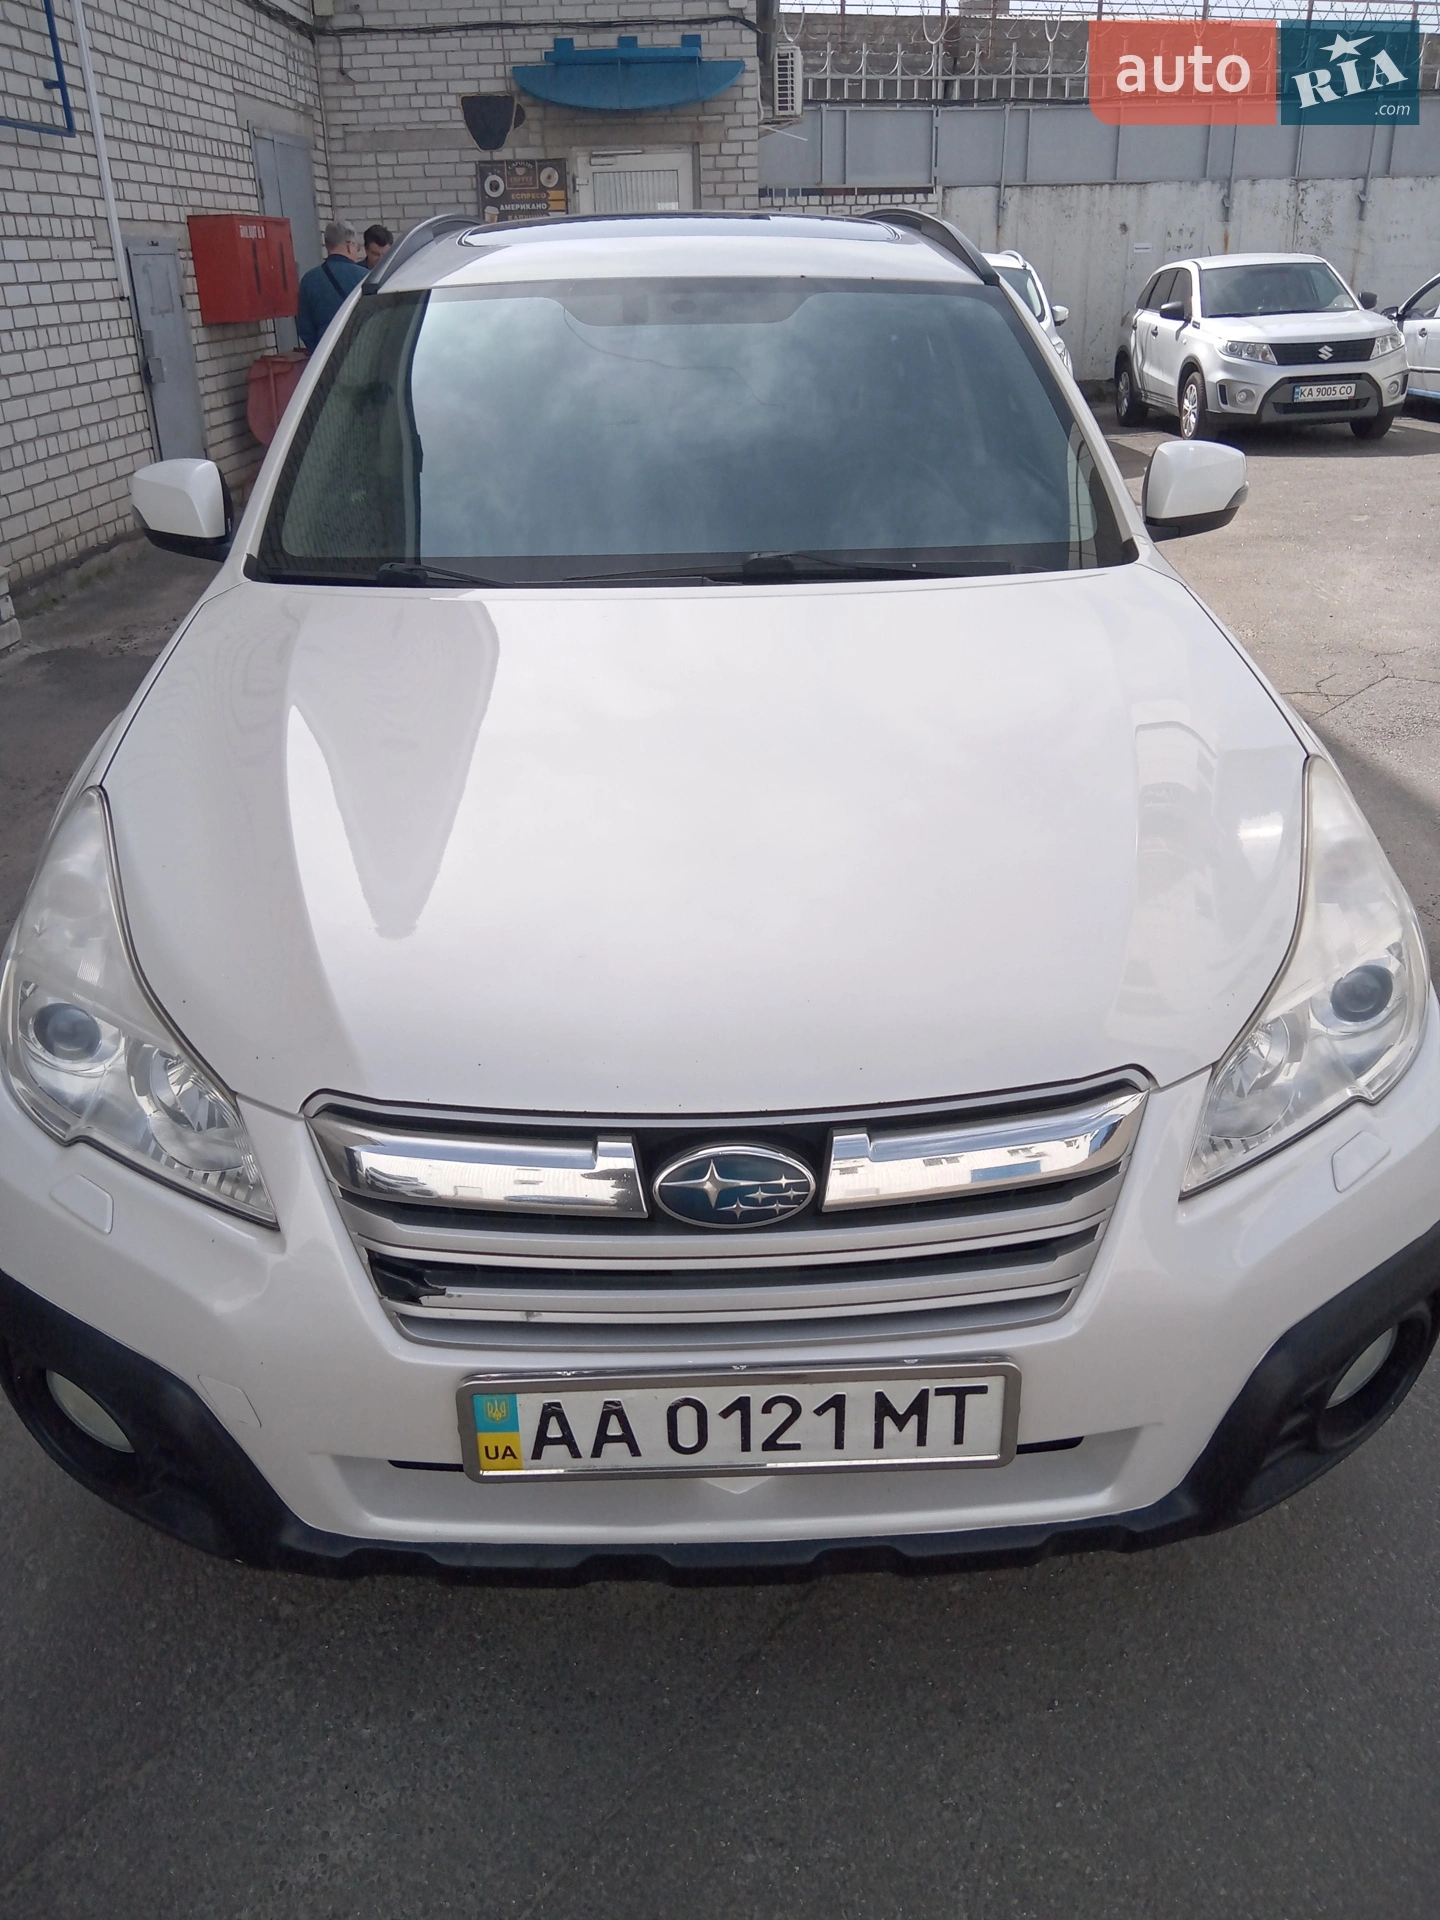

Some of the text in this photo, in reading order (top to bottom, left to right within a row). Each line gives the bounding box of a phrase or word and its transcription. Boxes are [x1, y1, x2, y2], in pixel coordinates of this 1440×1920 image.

[500, 203, 547, 211] АМЕРИКАНО
[1300, 386, 1352, 397] KA 9005 CO
[530, 1385, 988, 1460] AA 0121 MT
[484, 1448, 517, 1460] UA
